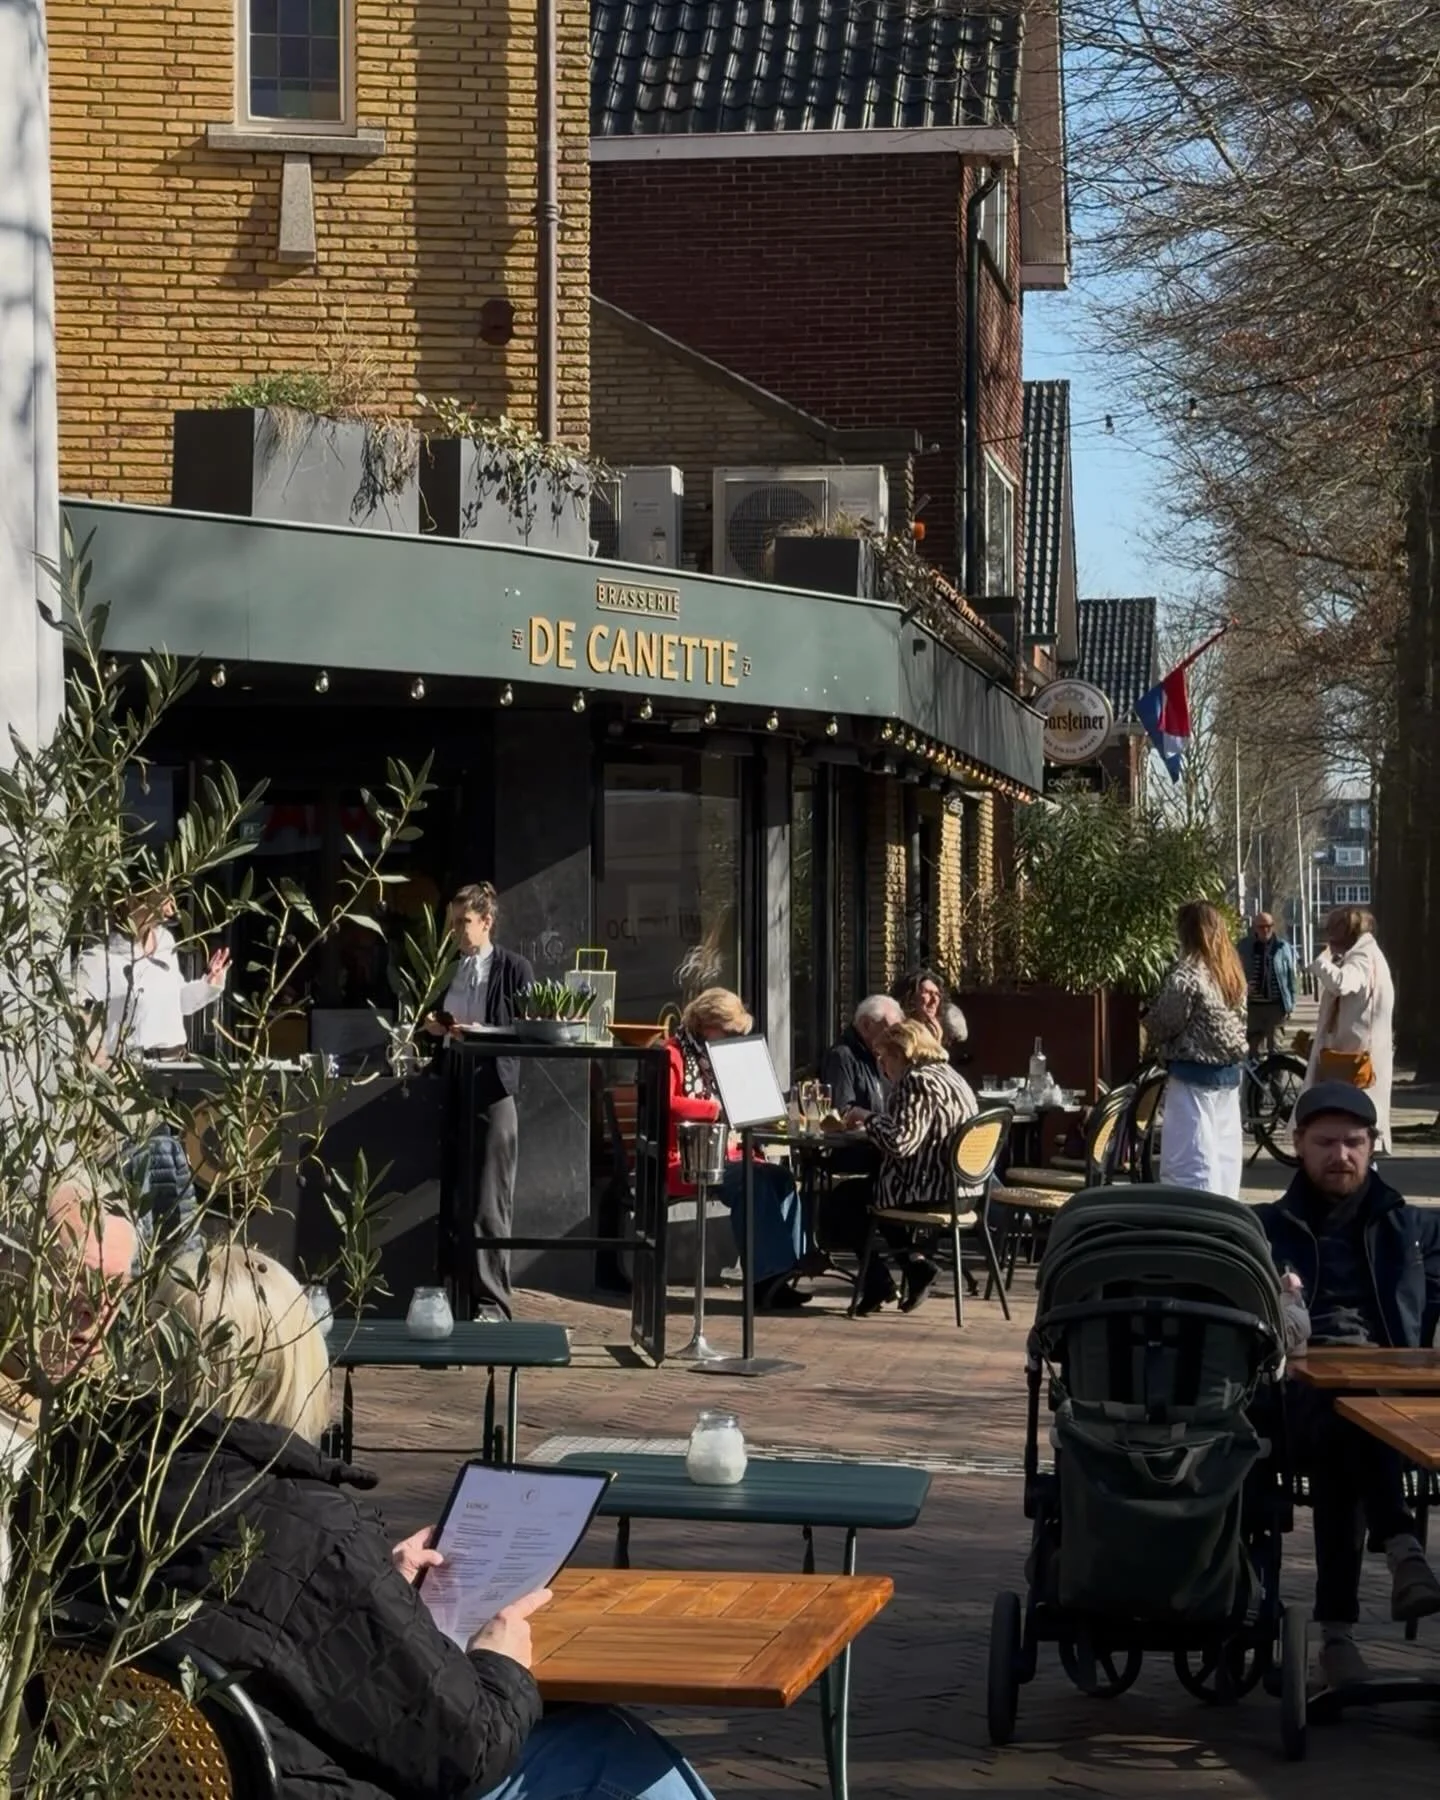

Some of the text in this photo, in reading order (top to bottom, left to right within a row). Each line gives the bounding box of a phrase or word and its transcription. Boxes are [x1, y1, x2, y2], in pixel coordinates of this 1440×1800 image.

[597, 584, 680, 613] BRASSERIE
[529, 616, 739, 687] DE CANETTE
